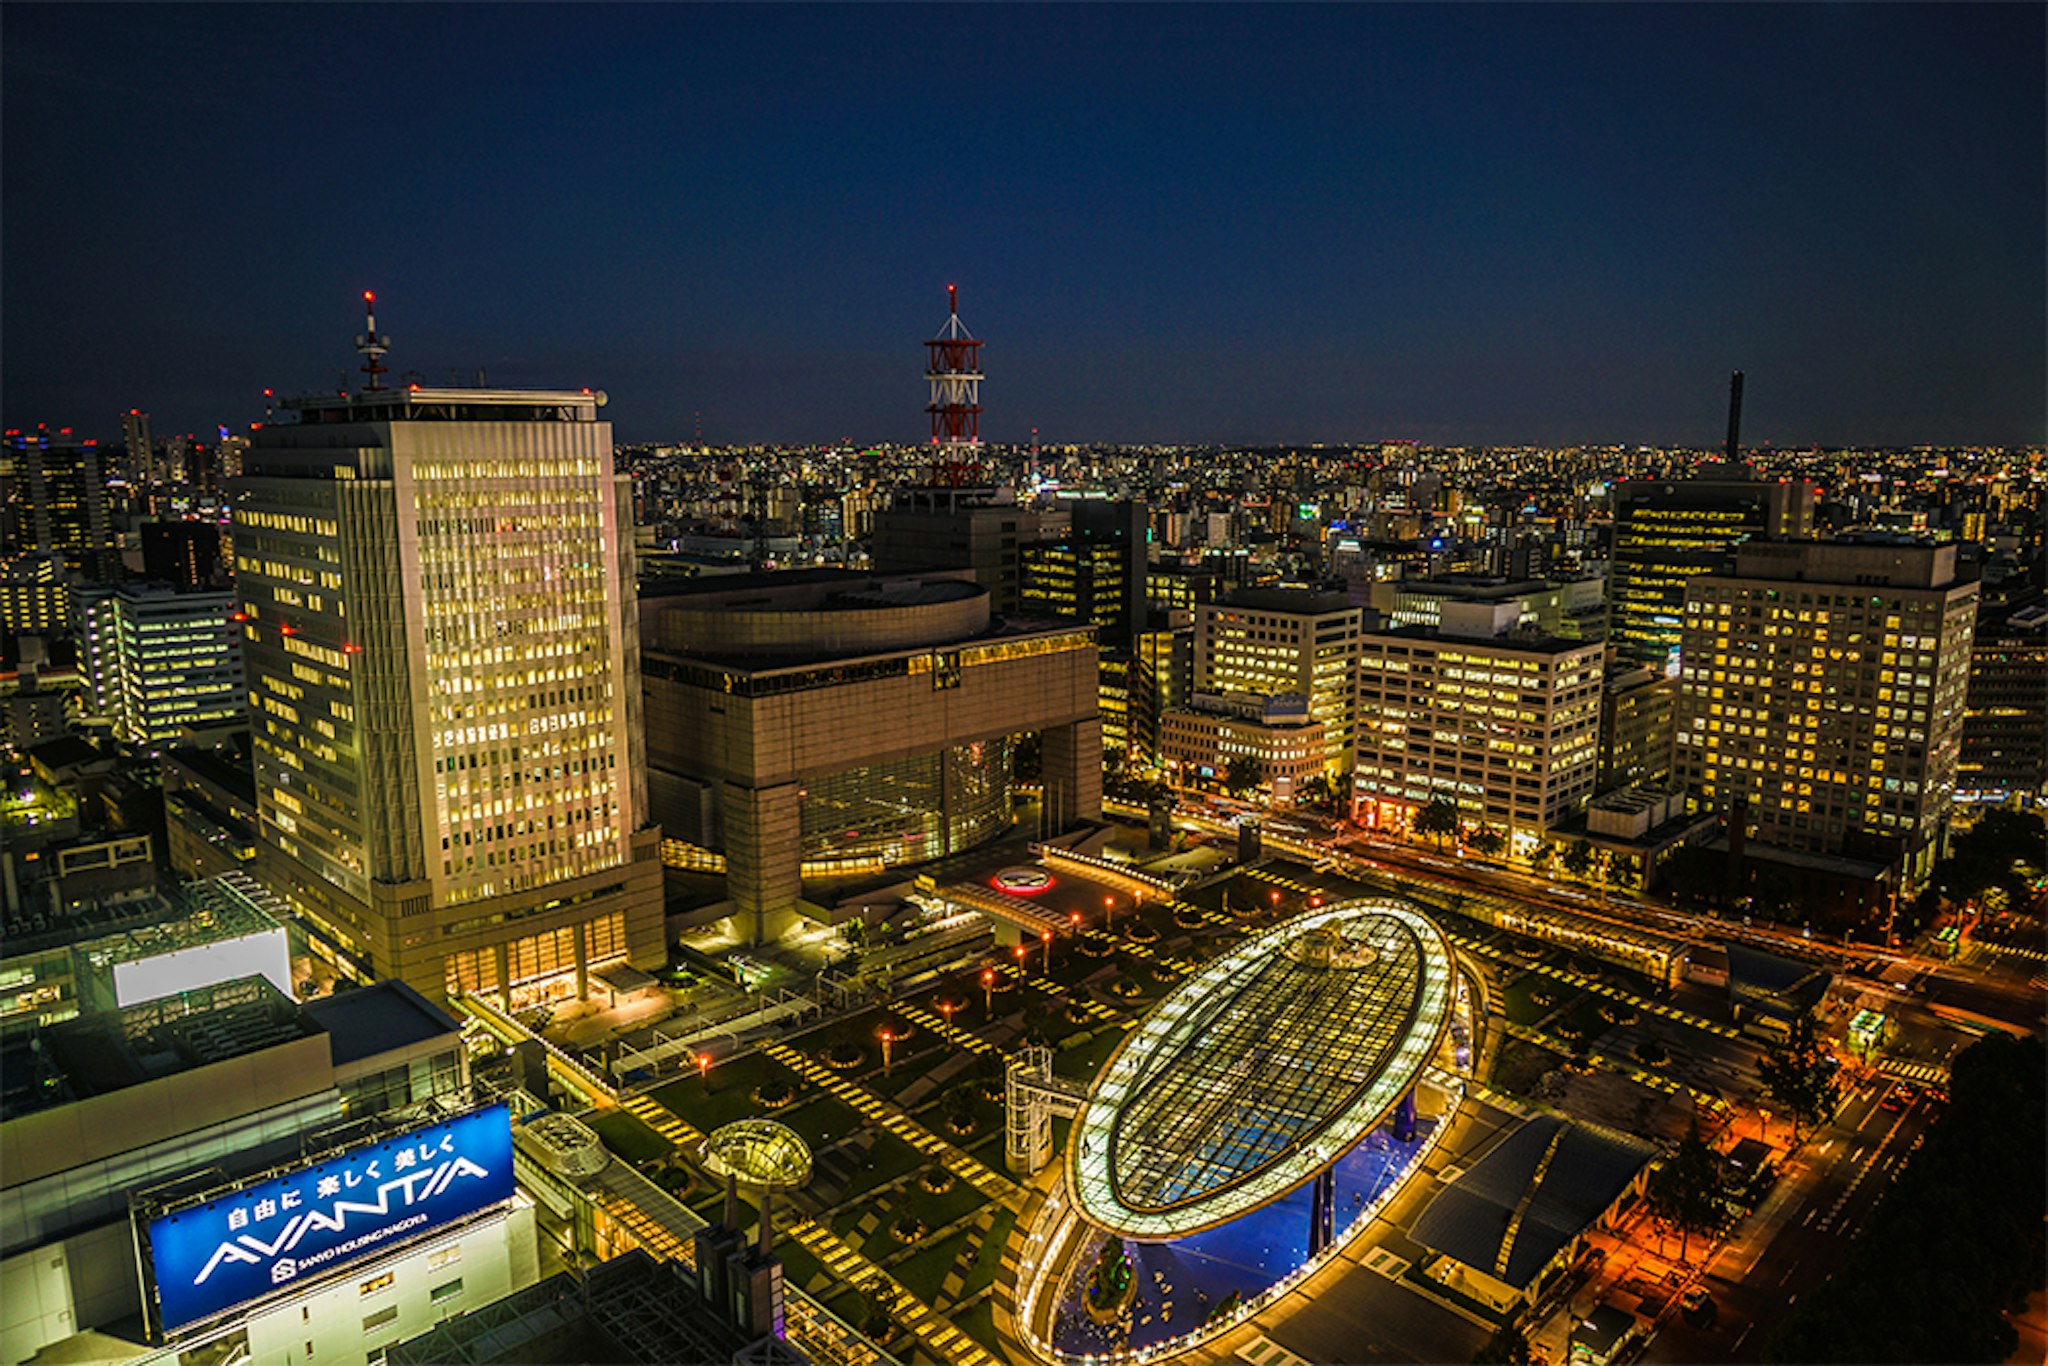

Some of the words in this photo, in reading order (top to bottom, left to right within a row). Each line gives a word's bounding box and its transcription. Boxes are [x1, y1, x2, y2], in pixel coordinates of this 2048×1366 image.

[194, 1156, 489, 1286] AVANTIA
[227, 1190, 302, 1231] 自由に
[316, 1160, 381, 1200] 楽しく
[394, 1134, 454, 1172] 美しく
[298, 1248, 335, 1271] SANYO
